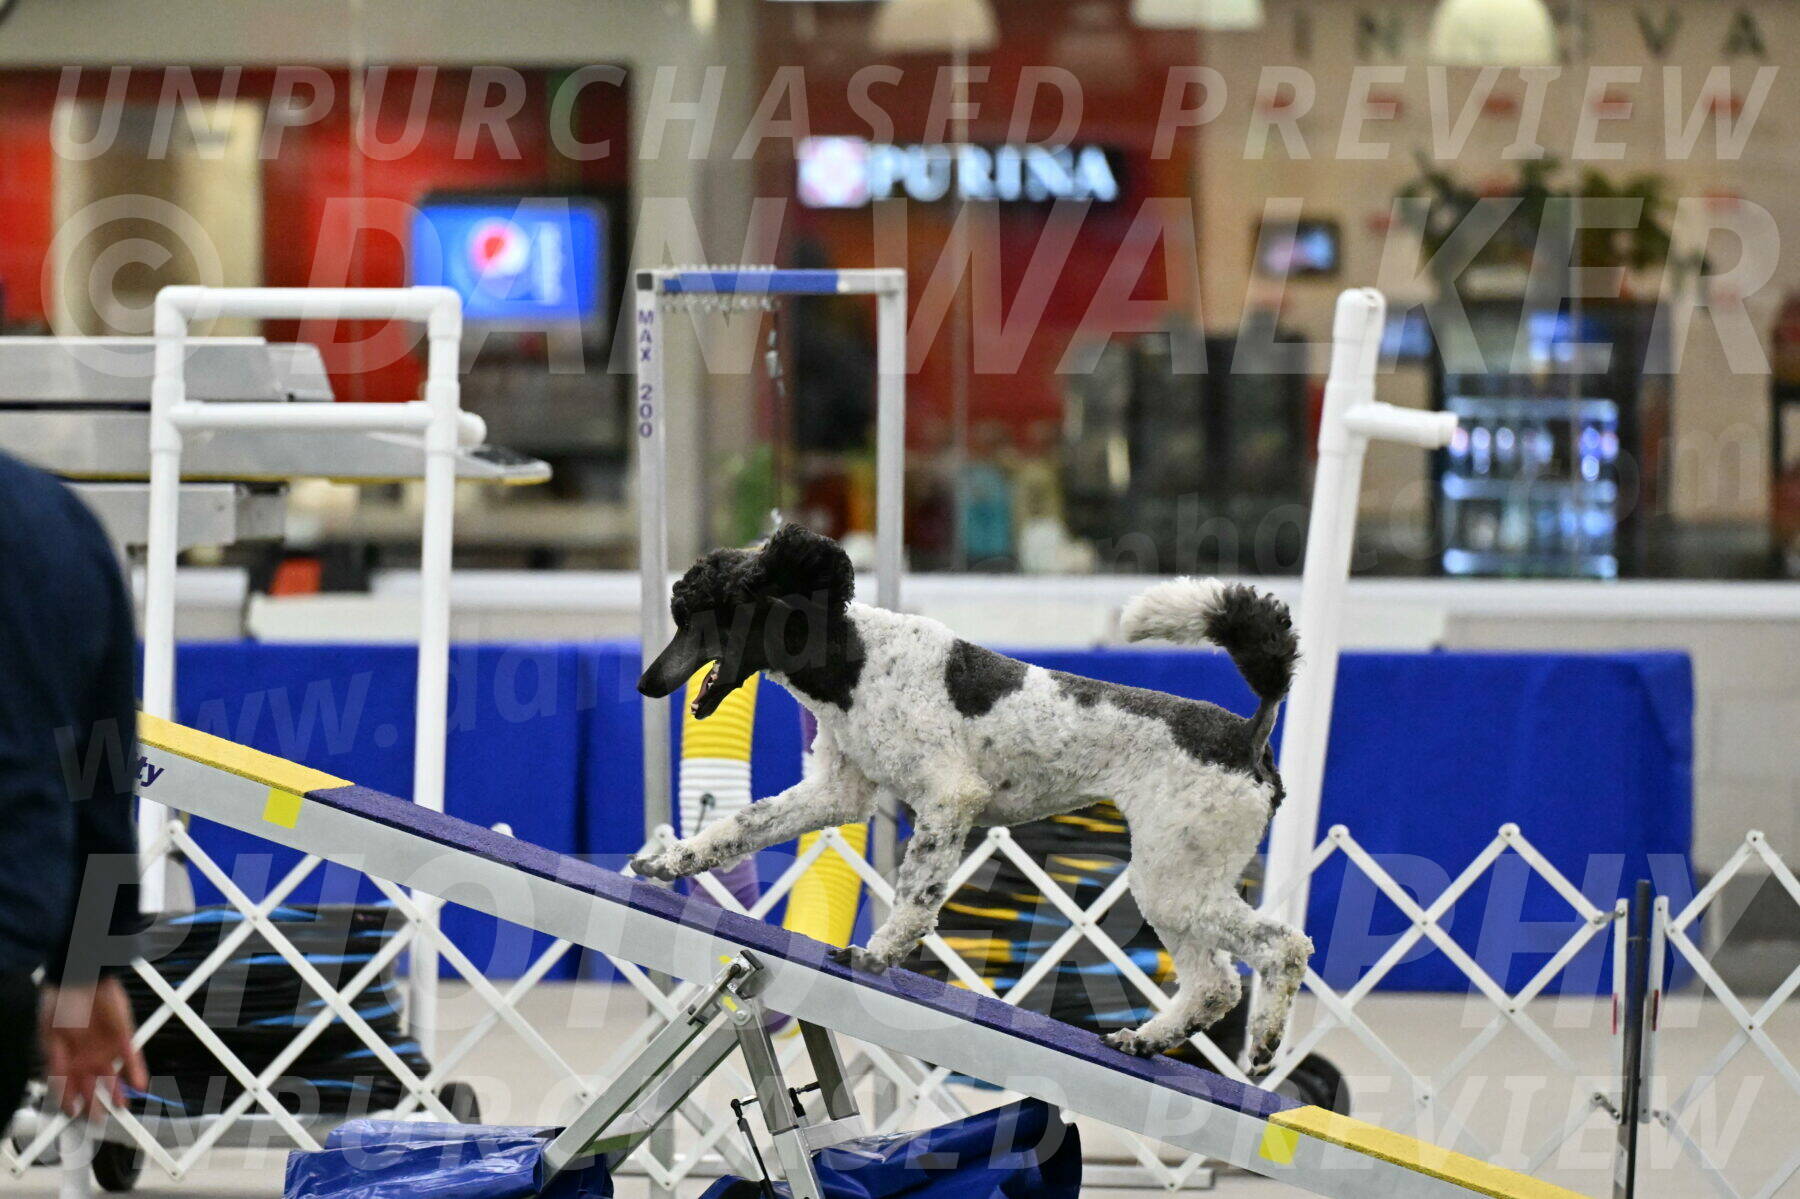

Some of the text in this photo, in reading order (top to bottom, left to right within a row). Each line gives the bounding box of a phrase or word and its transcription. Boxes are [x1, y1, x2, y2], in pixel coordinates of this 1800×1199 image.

[866, 142, 1120, 202] PURINA
[639, 309, 655, 438] MAX 200
